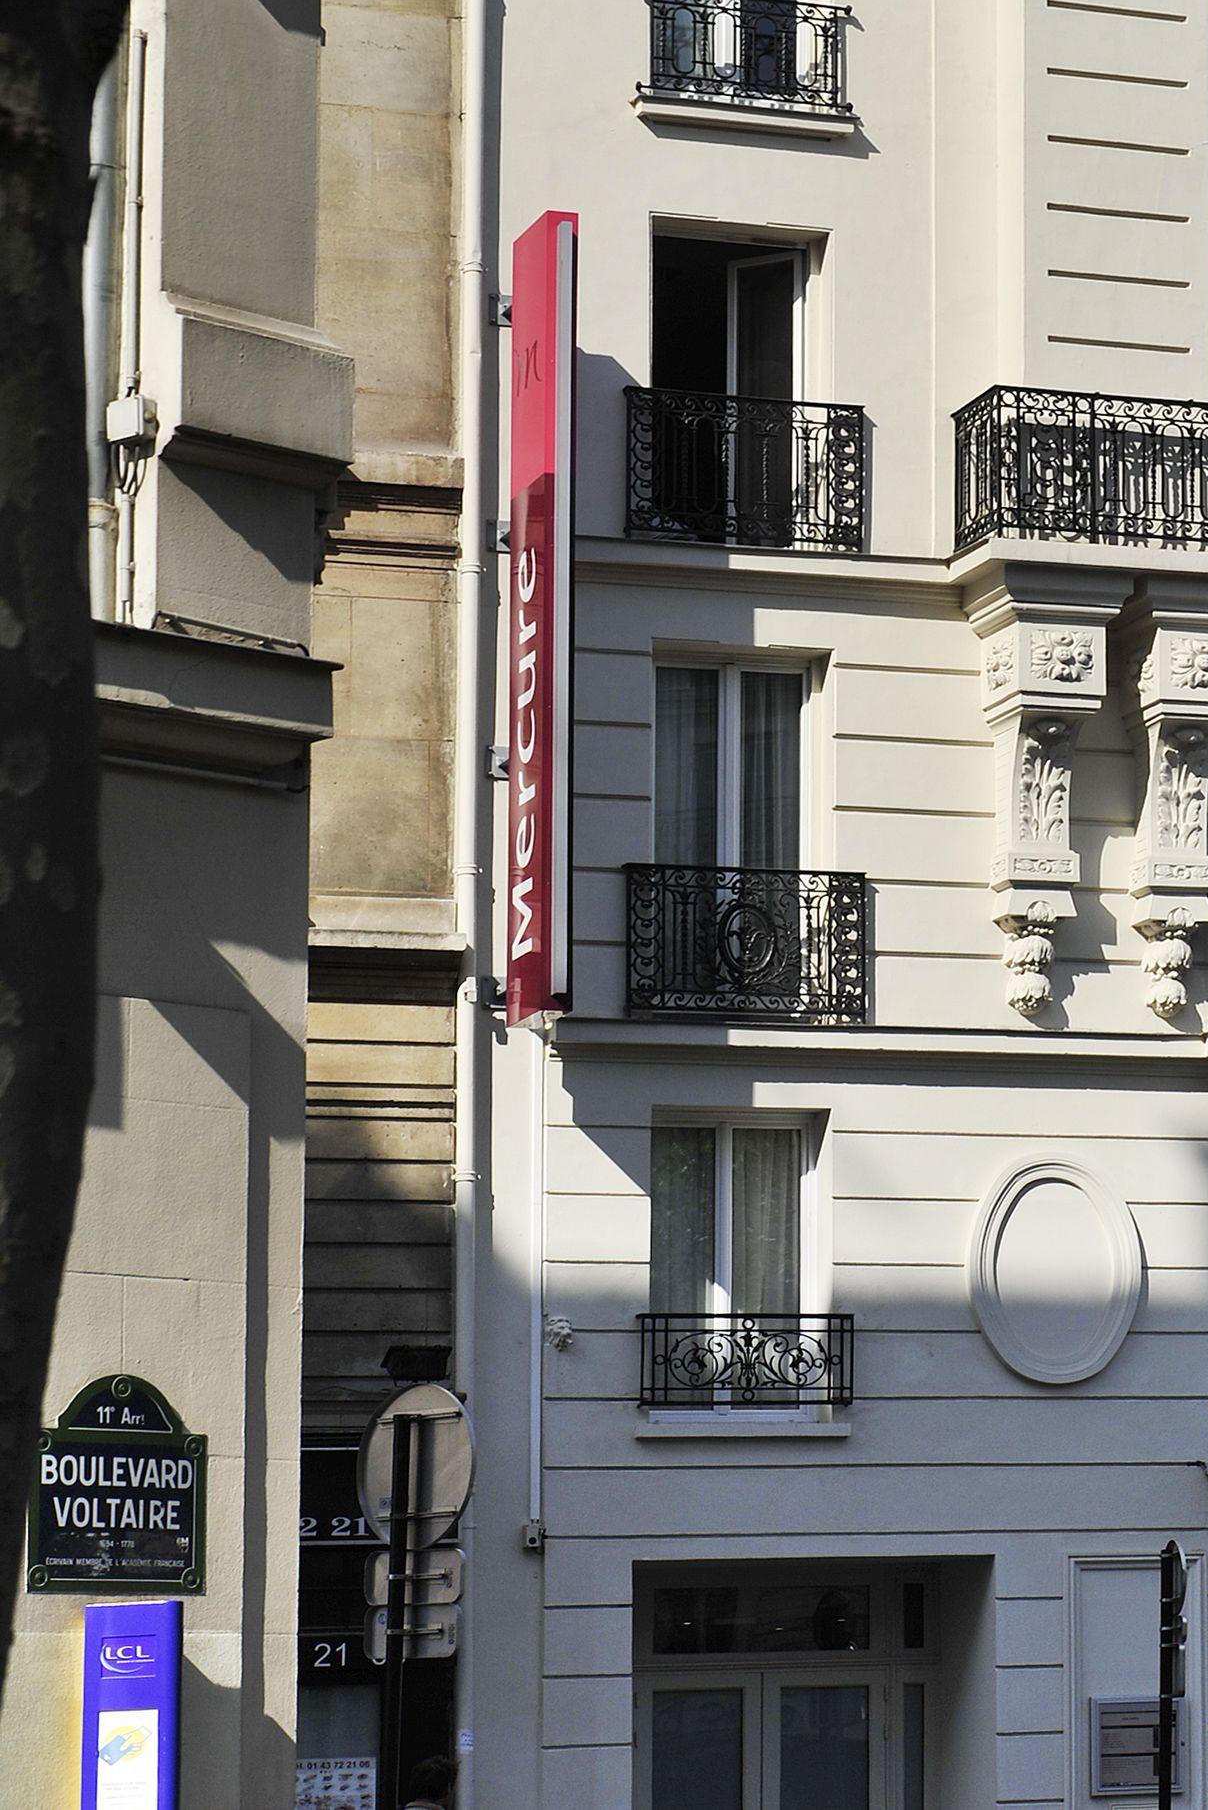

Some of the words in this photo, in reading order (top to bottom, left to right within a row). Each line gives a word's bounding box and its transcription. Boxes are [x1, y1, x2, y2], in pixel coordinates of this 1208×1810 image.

[511, 547, 537, 961] Mercure
[40, 1454, 193, 1490] BOULEVARD
[53, 1496, 181, 1530] VOLTAIRE
[331, 1516, 370, 1537] 21
[105, 1645, 150, 1660] LCL
[314, 1642, 347, 1667] 21
